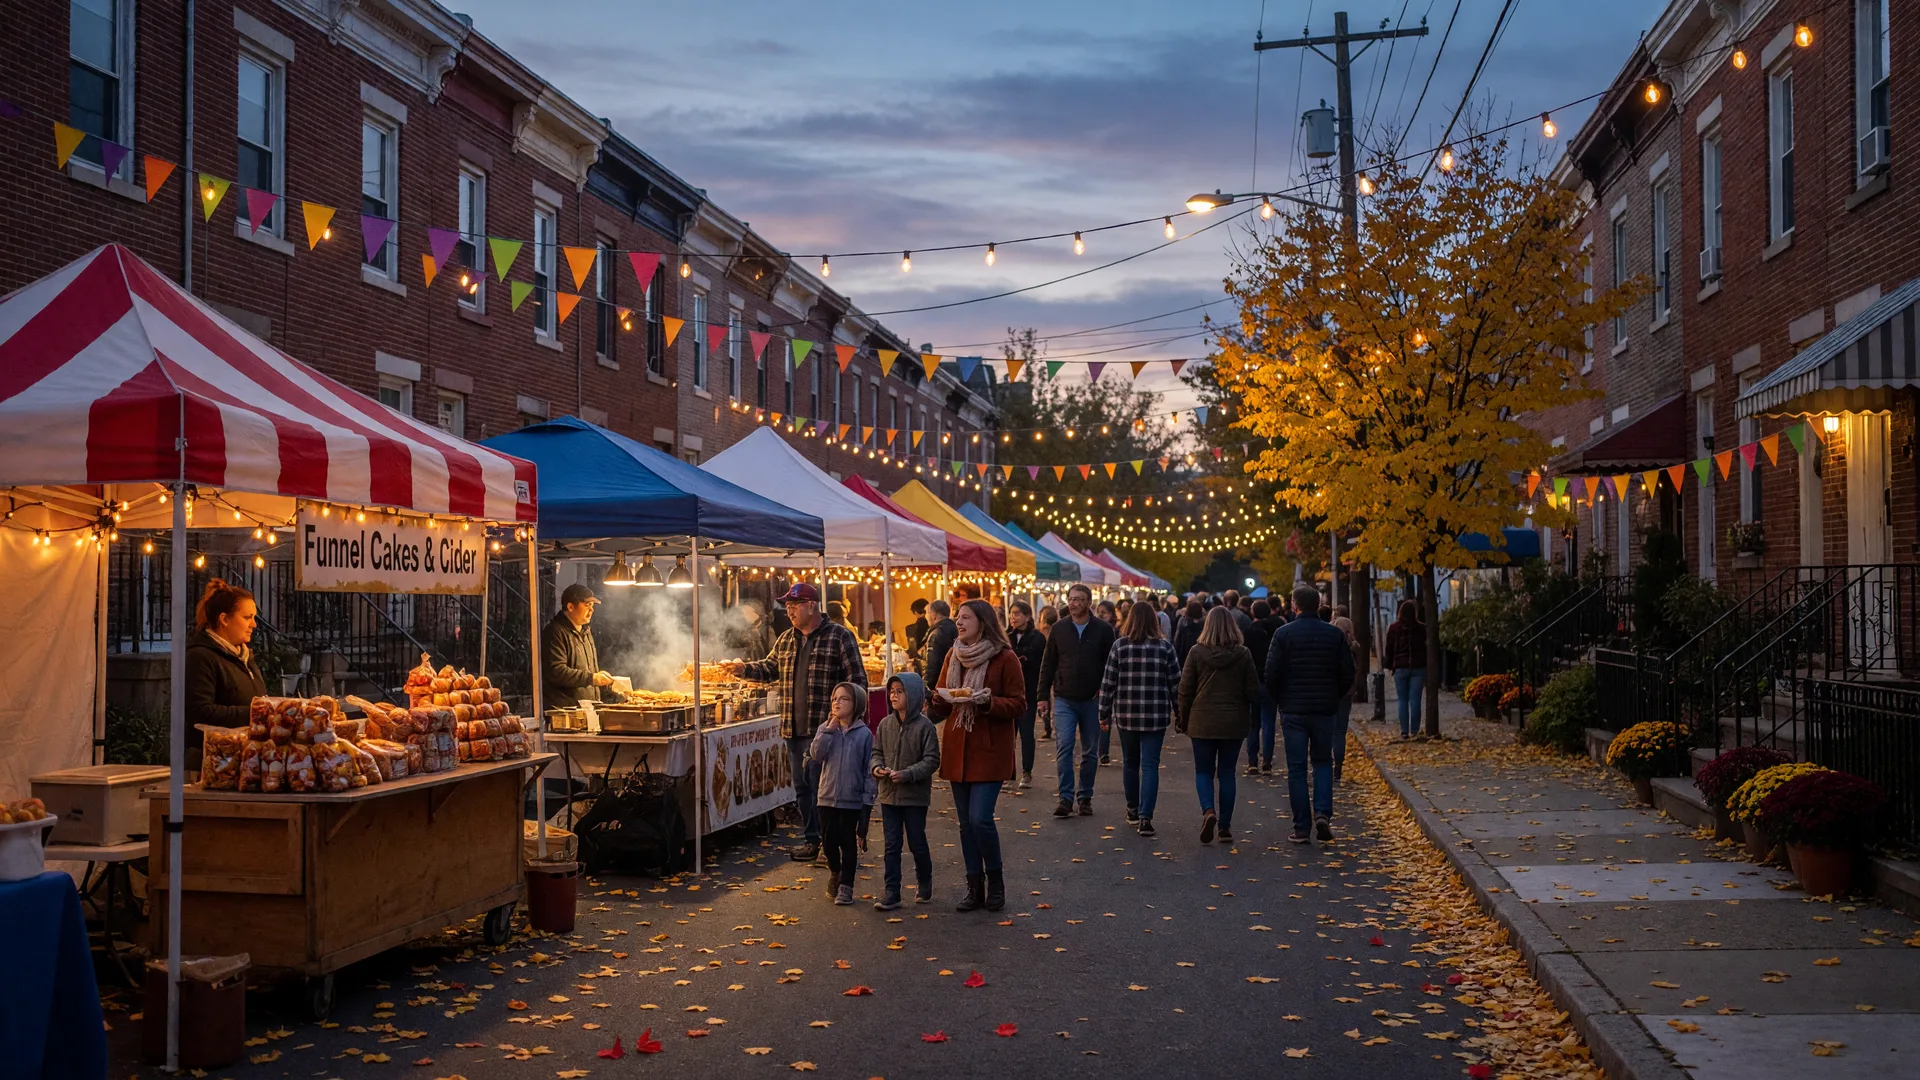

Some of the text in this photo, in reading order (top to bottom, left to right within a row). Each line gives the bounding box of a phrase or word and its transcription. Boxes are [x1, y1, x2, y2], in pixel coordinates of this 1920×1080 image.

[305, 524, 477, 575] Funnel Cakes & Cider
